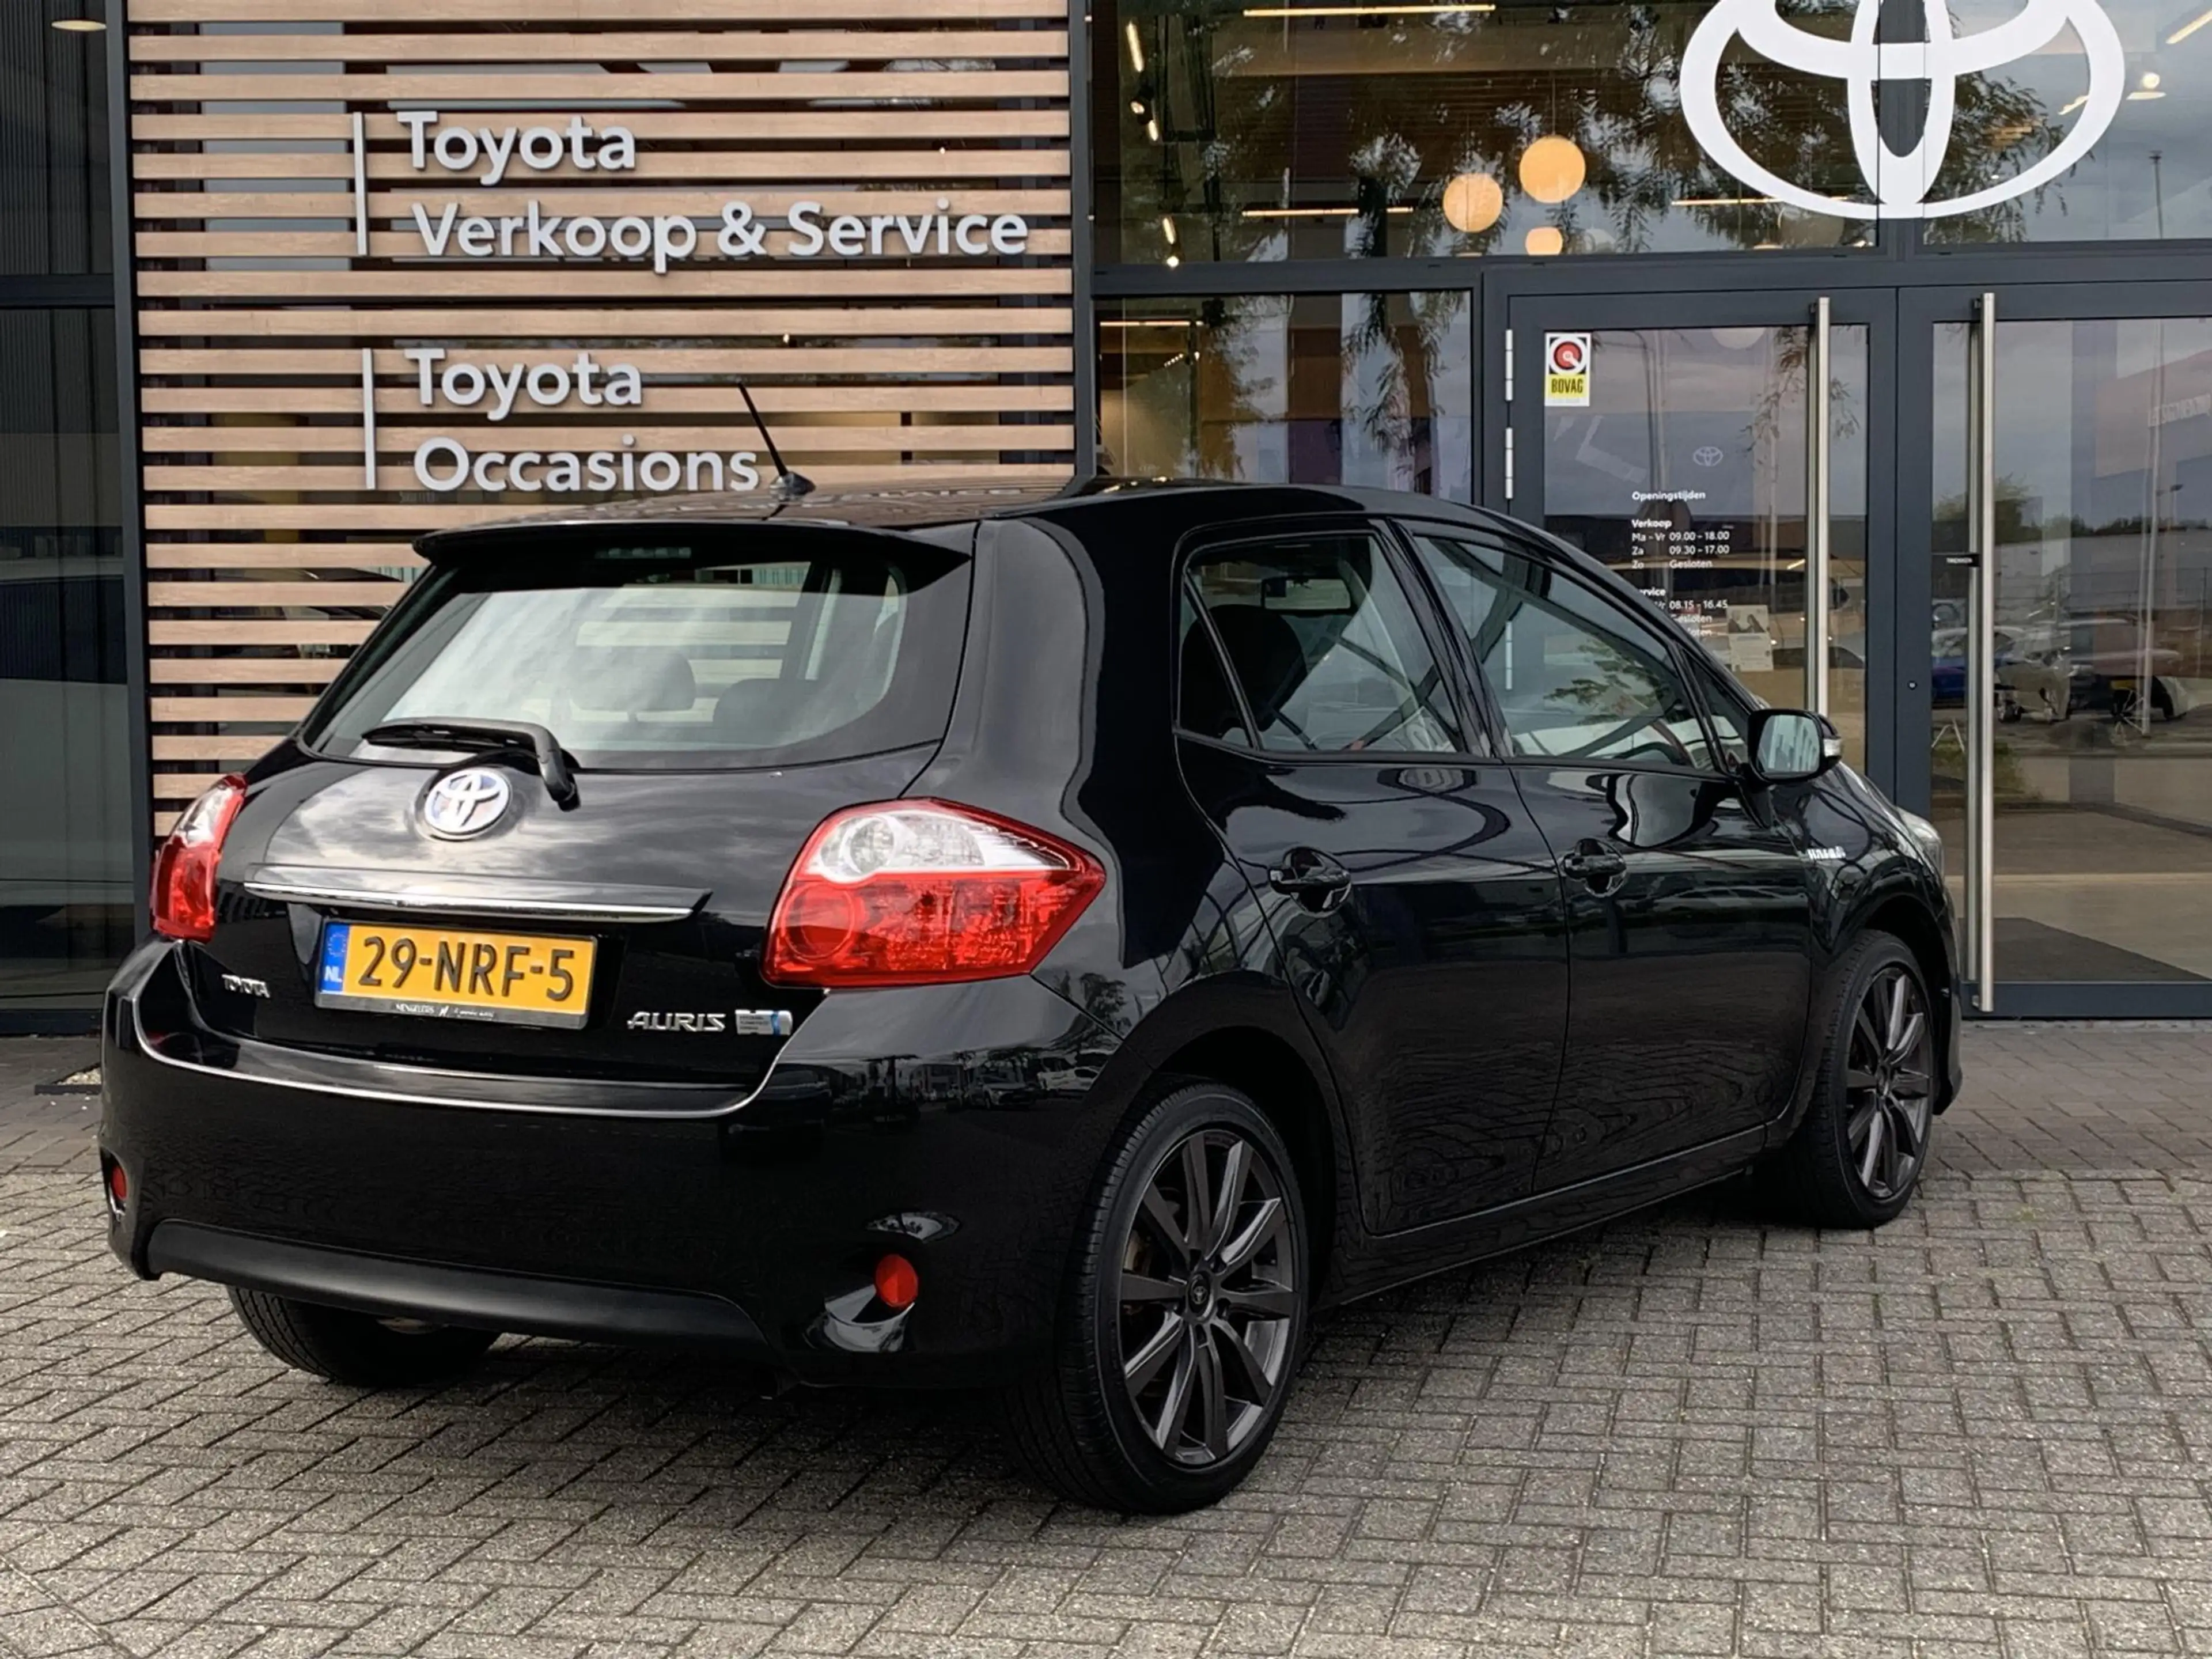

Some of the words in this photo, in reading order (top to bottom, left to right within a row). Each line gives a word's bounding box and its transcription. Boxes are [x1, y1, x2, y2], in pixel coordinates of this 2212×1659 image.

[396, 111, 635, 185] Toyota
[411, 199, 696, 274] Verkoop
[717, 201, 767, 255] &
[787, 196, 1028, 255] Service
[404, 348, 642, 421] Toyota
[1551, 378, 1584, 393] BOVAG
[414, 434, 760, 491] Occasions
[1631, 491, 1706, 502] Openingstijden
[1631, 519, 1672, 529] Verkoop
[1631, 533, 1646, 541] Ma
[1655, 533, 1666, 541] Vr
[1669, 531, 1696, 541] 09.00
[1705, 531, 1730, 540] 18.00
[1631, 546, 1645, 556] Za
[1669, 546, 1696, 556] 09.30
[1705, 545, 1730, 554] 17.00
[1669, 559, 1713, 569] Gesloten
[1669, 600, 1694, 609] 08.15
[1703, 600, 1728, 609] 16.45
[325, 964, 343, 983] NL
[358, 935, 575, 1001] 29-NRF-5
[627, 1011, 726, 1032] AURIS
